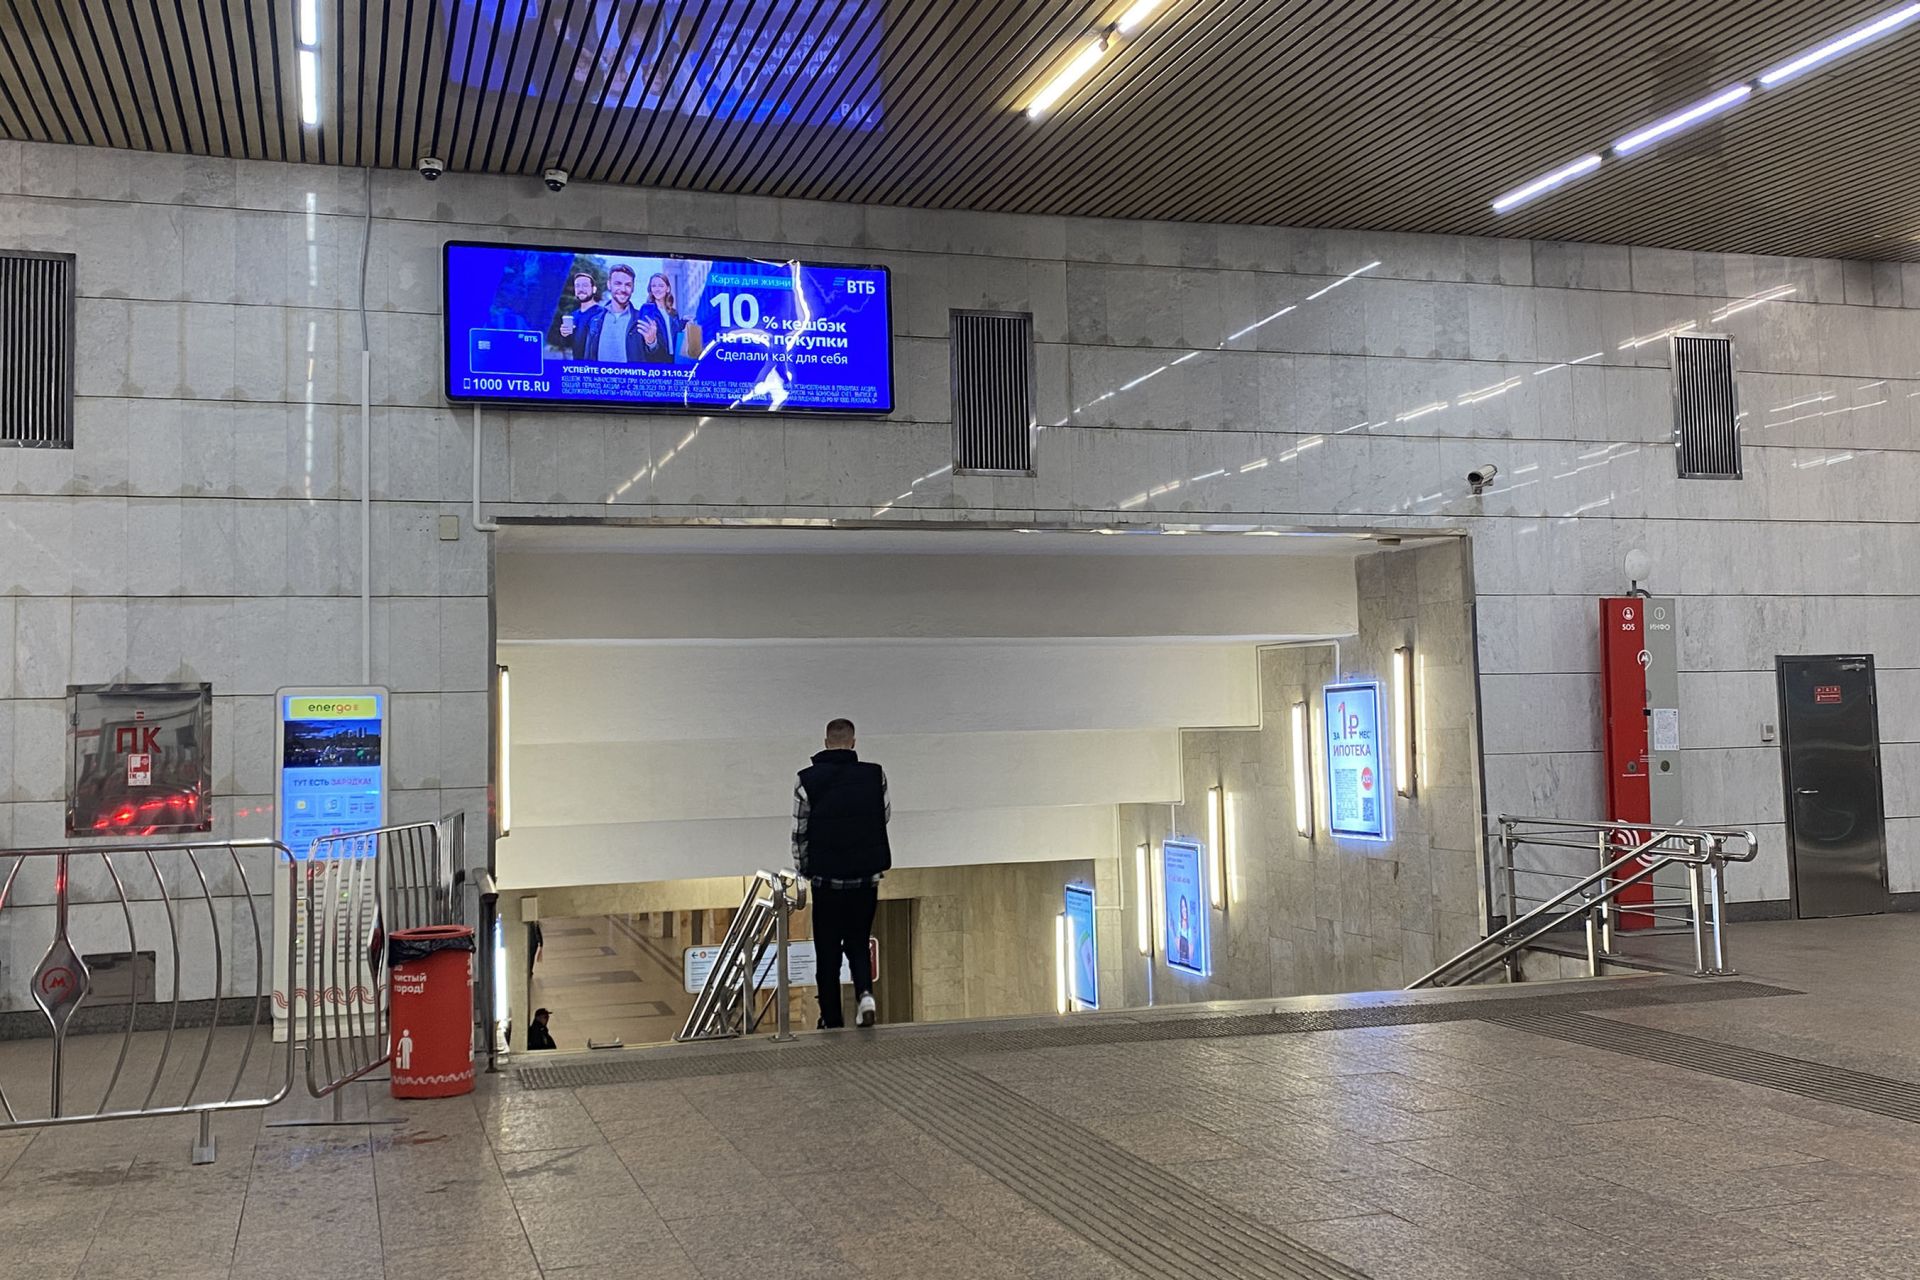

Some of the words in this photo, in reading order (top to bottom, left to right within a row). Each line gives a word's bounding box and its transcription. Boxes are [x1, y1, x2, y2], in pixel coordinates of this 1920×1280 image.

[711, 274, 741, 287] Карта
[742, 276, 759, 287] для
[761, 277, 792, 288] жизни
[847, 280, 876, 295] ВТБ
[709, 292, 760, 329] 10
[762, 316, 779, 330] %
[782, 317, 847, 333] кешбэк
[716, 332, 737, 344] на
[774, 335, 848, 349] покупки
[715, 349, 769, 362] Сделали
[772, 352, 793, 363] как
[796, 354, 818, 365] для
[821, 352, 848, 365] себя
[562, 366, 600, 375] УСПЕЙТЕ
[600, 367, 647, 376] ОФОРМИТЬ
[648, 369, 661, 378] ДО
[473, 378, 503, 390] 1000
[507, 380, 550, 392] VTB.RU
[1621, 623, 1636, 631] SOS
[1649, 623, 1671, 631] ИНФО
[308, 704, 352, 714] energo
[116, 727, 162, 753] ПК
[1333, 744, 1371, 757] ИПОТЕКА
[294, 779, 309, 787] ТУТ
[394, 972, 427, 982] чистый
[394, 983, 424, 995] город!
